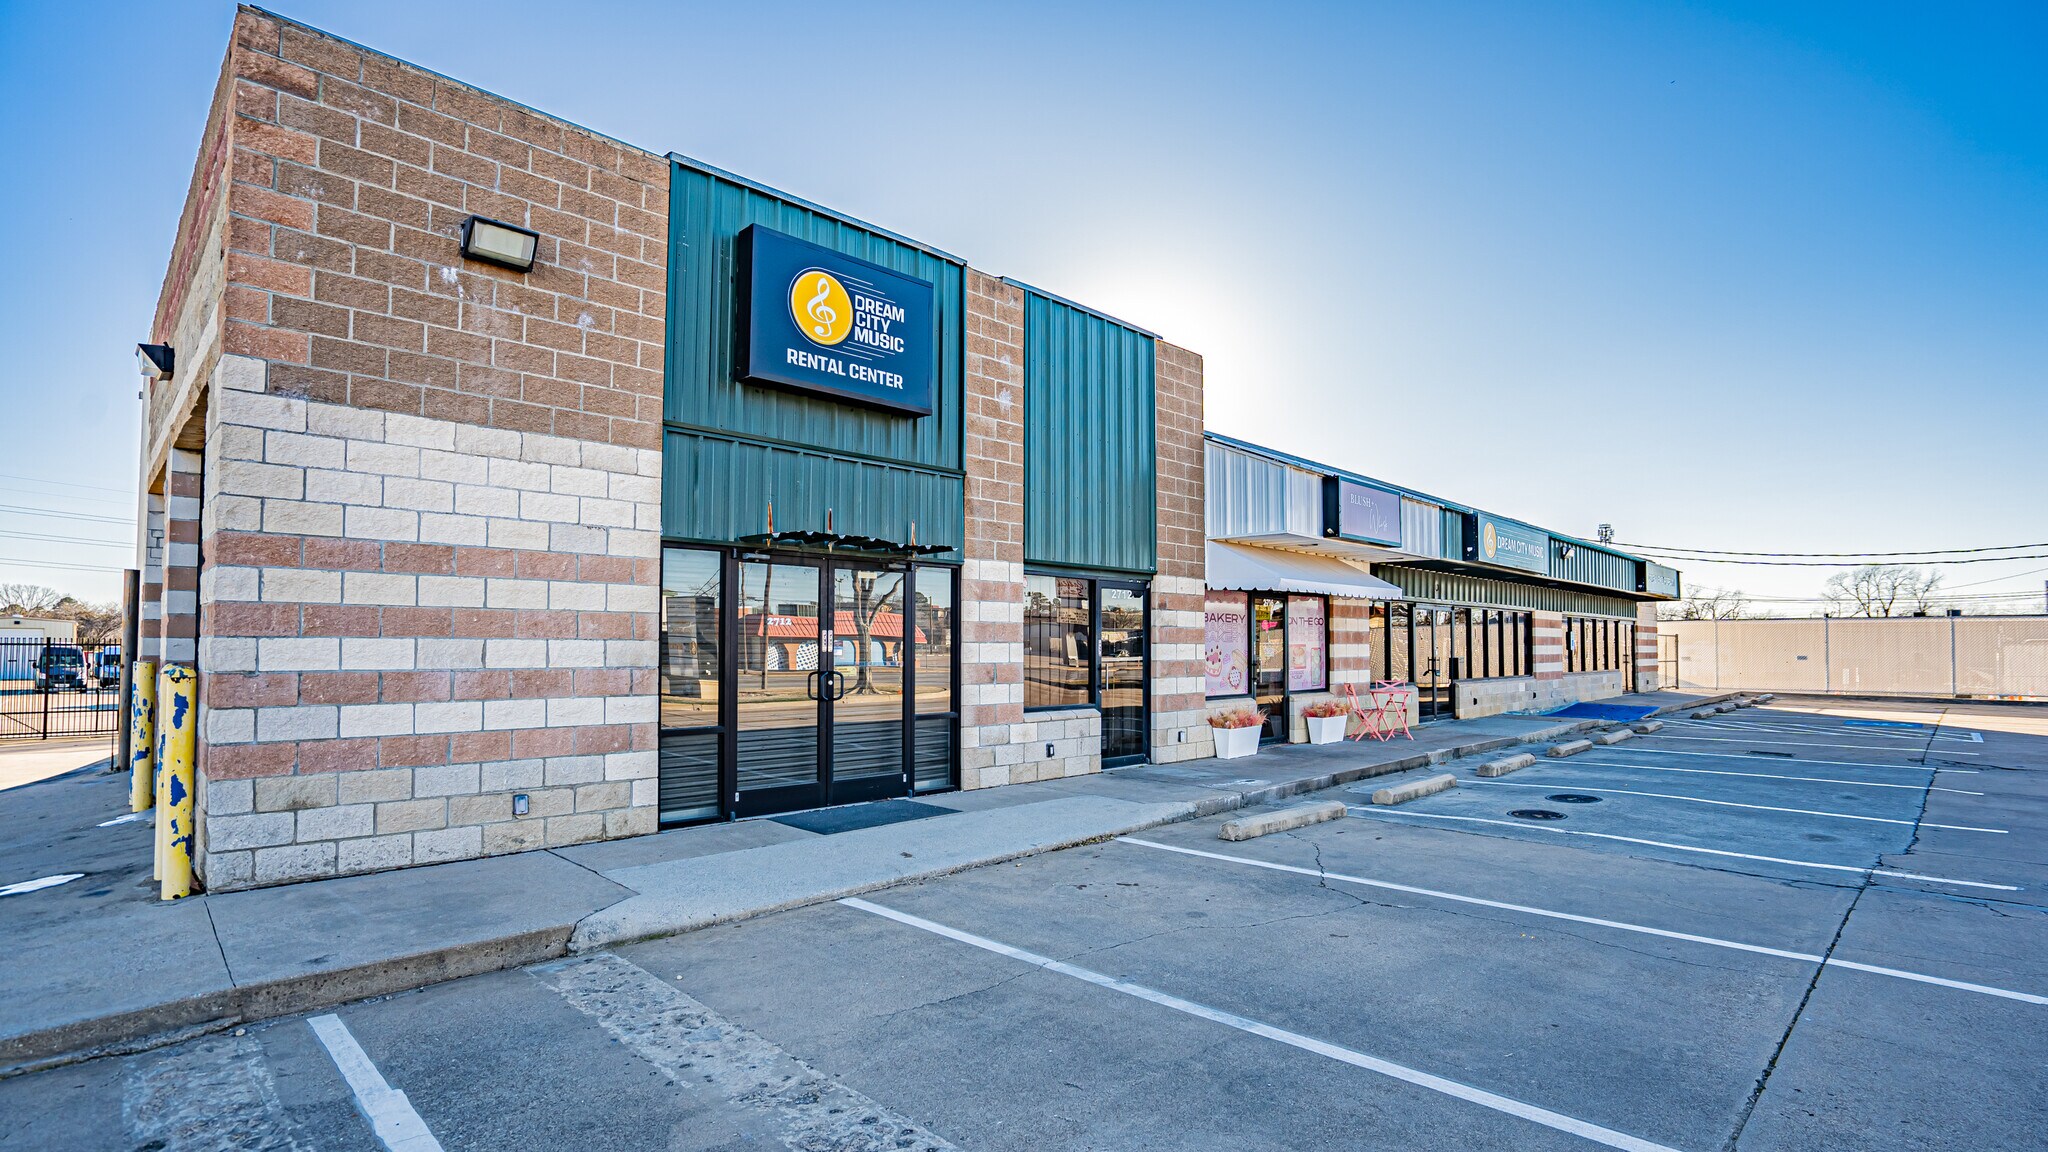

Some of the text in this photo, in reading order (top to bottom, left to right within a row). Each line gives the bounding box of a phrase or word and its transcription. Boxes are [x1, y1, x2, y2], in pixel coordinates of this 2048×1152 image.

[855, 294, 905, 323] DREAM
[856, 311, 891, 333] CITY
[854, 326, 905, 353] MUSIC
[787, 348, 904, 390] RENTAL CENTER
[1350, 493, 1371, 508] BLUSH
[1497, 535, 1544, 559] DREAM CITY MUSIC
[1111, 589, 1133, 599] 2712
[767, 617, 792, 627] 2712
[1205, 612, 1246, 623] BAKERY
[1299, 616, 1313, 625] THE
[1314, 617, 1324, 625] GO
